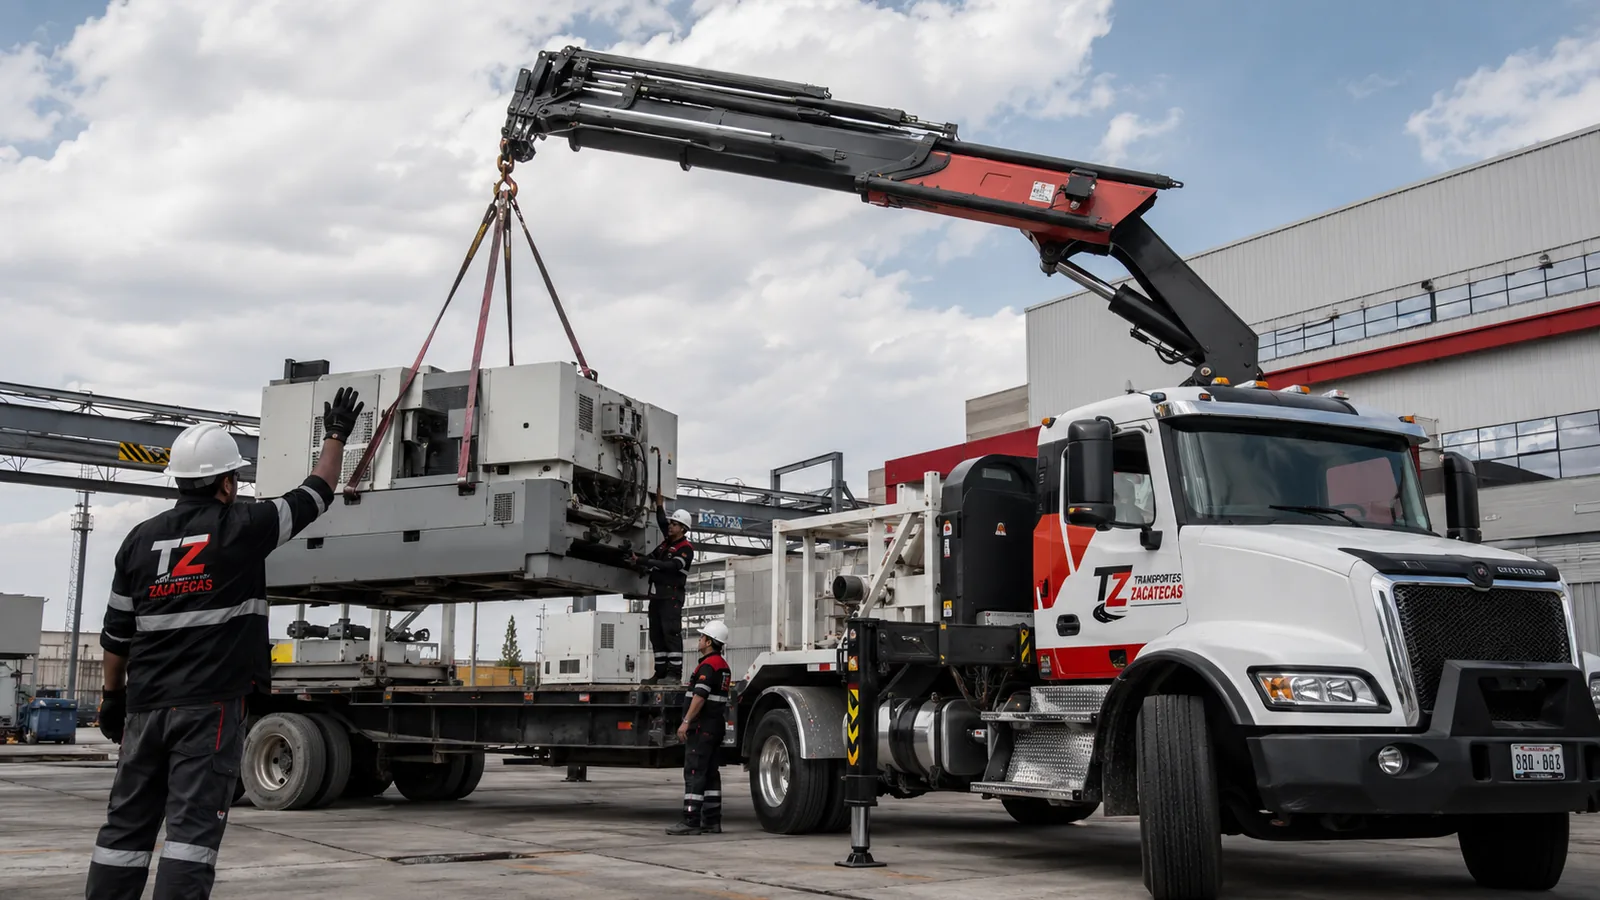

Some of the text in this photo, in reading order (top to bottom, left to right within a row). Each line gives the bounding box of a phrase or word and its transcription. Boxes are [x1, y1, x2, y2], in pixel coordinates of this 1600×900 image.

[150, 533, 211, 577] TZ
[1093, 565, 1133, 607] TZ
[1130, 584, 1183, 601] ZACATECAS
